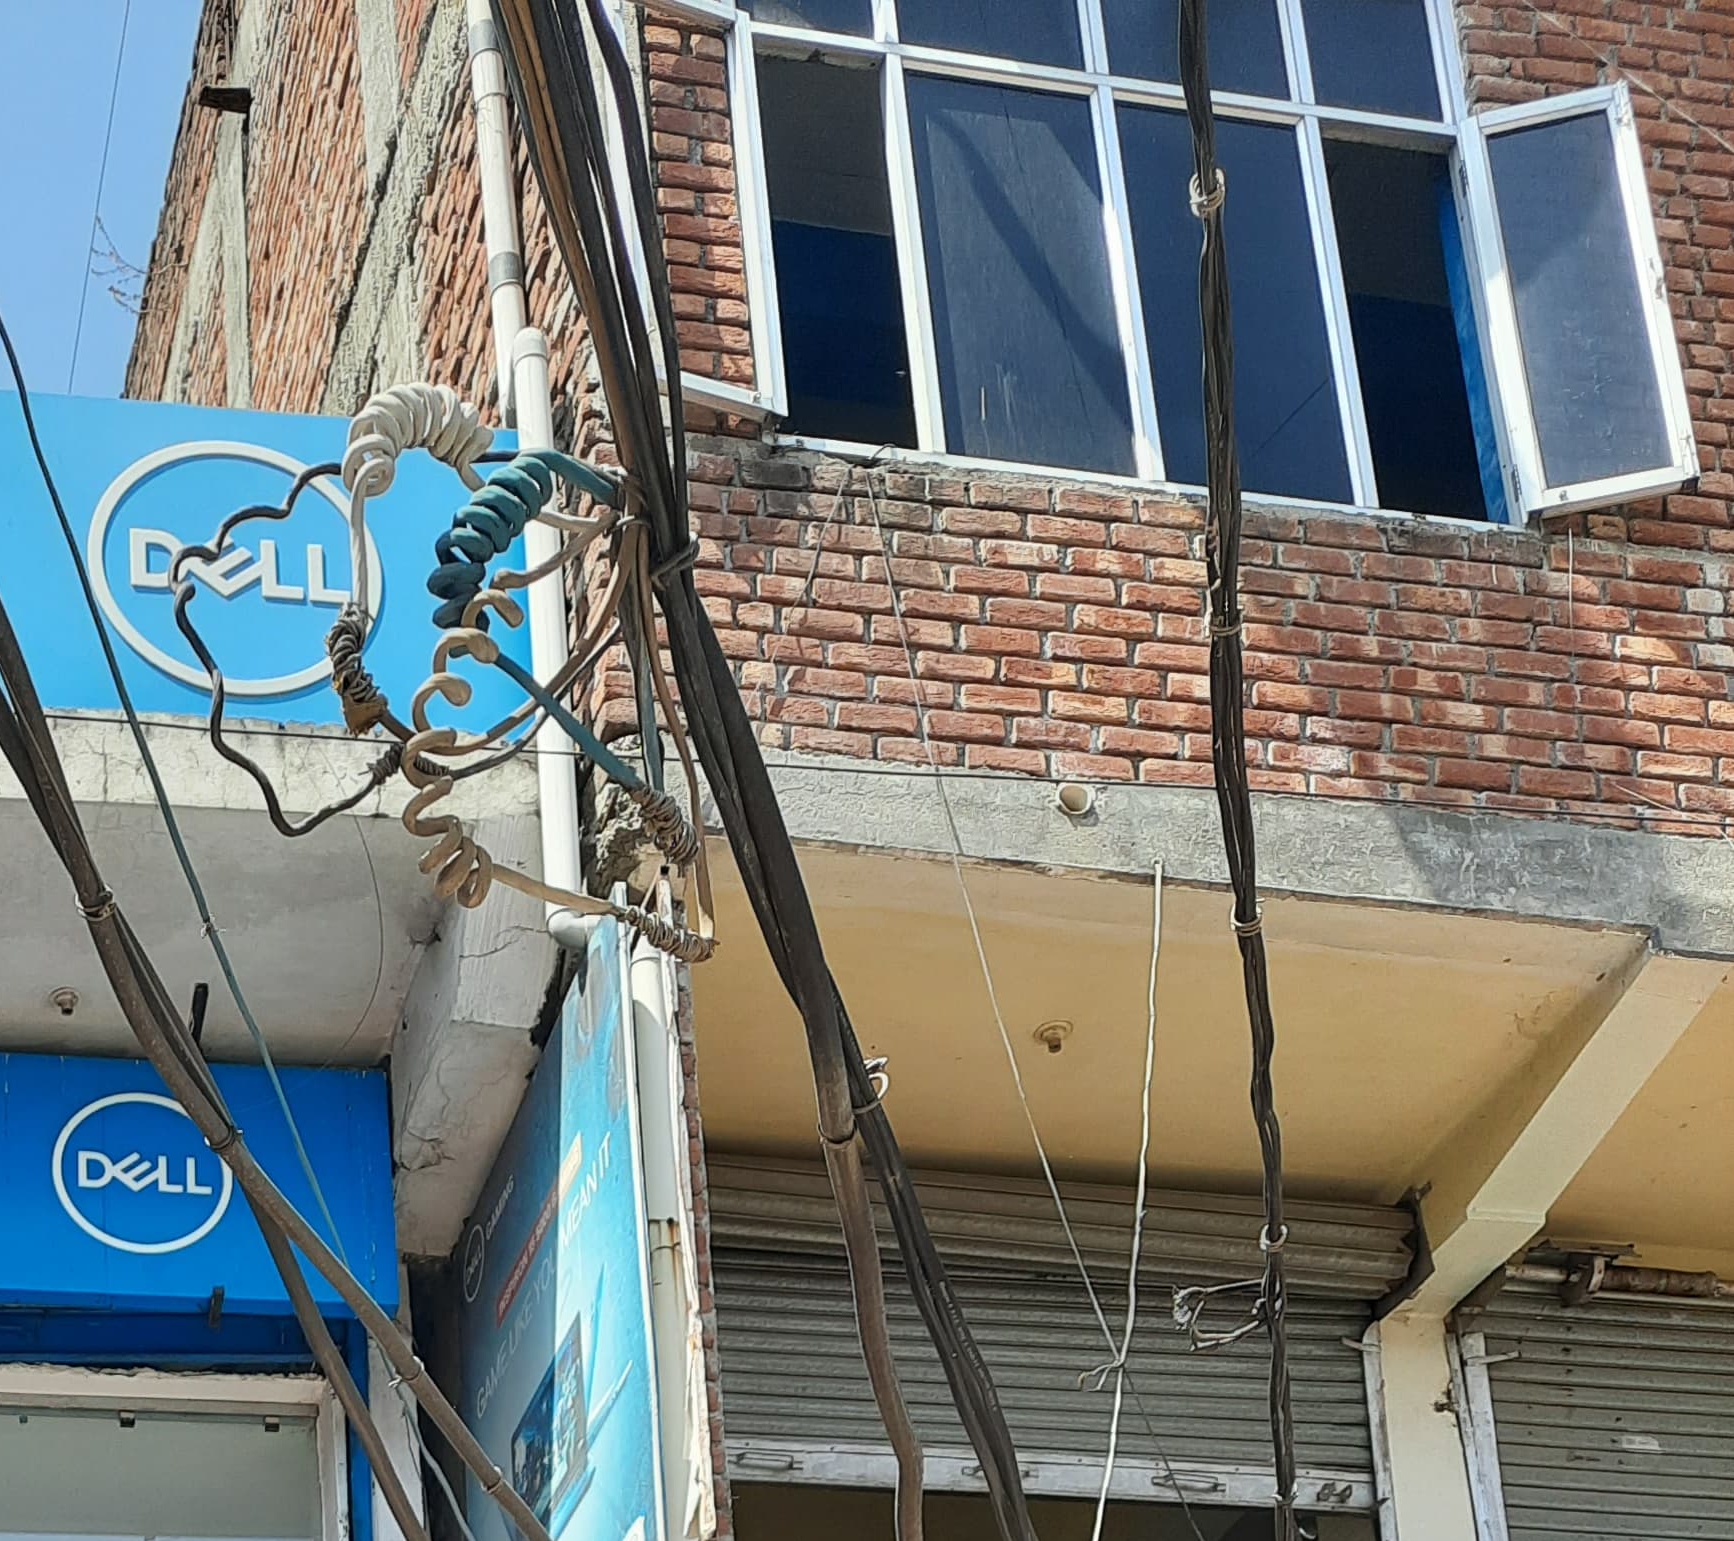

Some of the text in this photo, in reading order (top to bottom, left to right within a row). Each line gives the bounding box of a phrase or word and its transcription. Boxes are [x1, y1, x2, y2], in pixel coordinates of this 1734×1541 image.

[129, 528, 354, 606] DELL
[77, 1149, 212, 1197] DELL
[476, 1339, 509, 1420] GAME
[508, 1296, 534, 1354] LIKE
[560, 1162, 599, 1250] MEAN
[598, 1130, 612, 1180] IT
